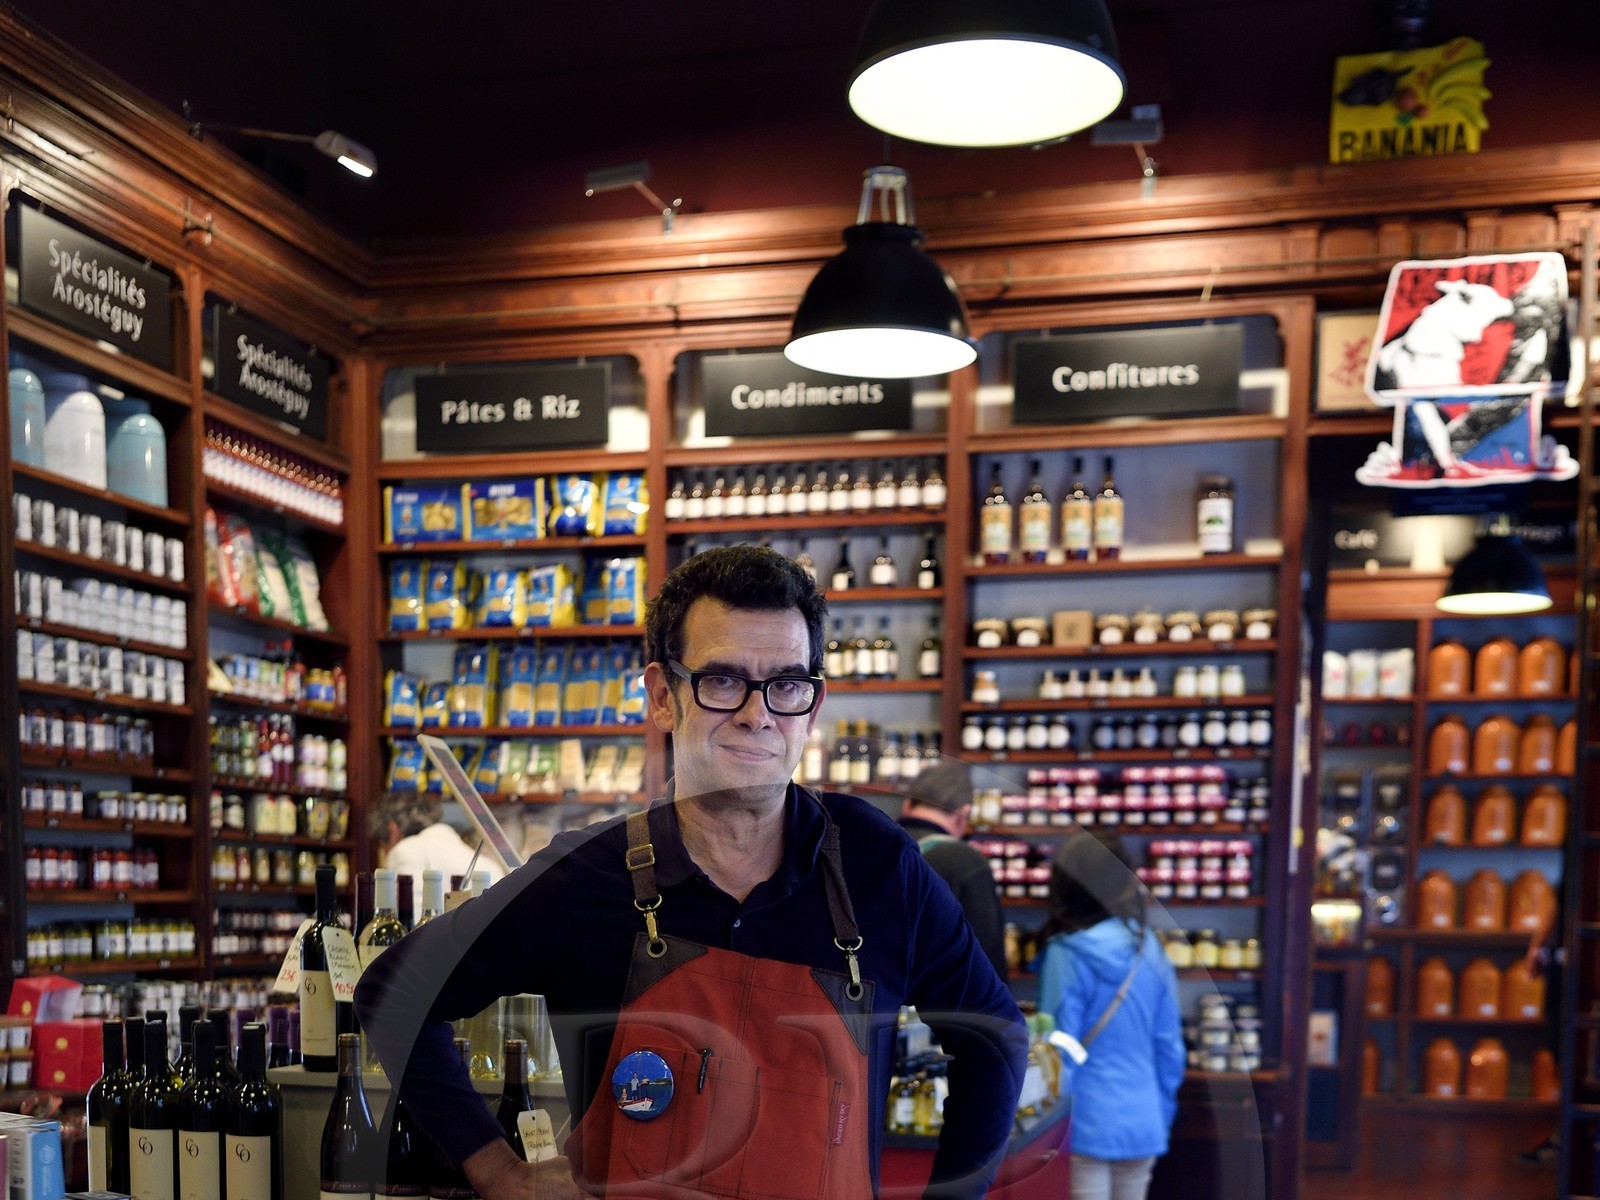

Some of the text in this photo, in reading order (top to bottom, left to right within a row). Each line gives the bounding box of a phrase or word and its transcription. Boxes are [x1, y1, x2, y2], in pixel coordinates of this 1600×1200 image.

[1338, 121, 1468, 162] BANANIA
[48, 238, 146, 310] Spécialités
[52, 272, 144, 342] Arostéguy
[236, 333, 313, 393] Spécialités
[1051, 362, 1200, 393] Confitures
[440, 393, 582, 425] Pâtes & Riz
[730, 382, 884, 410] Condiments
